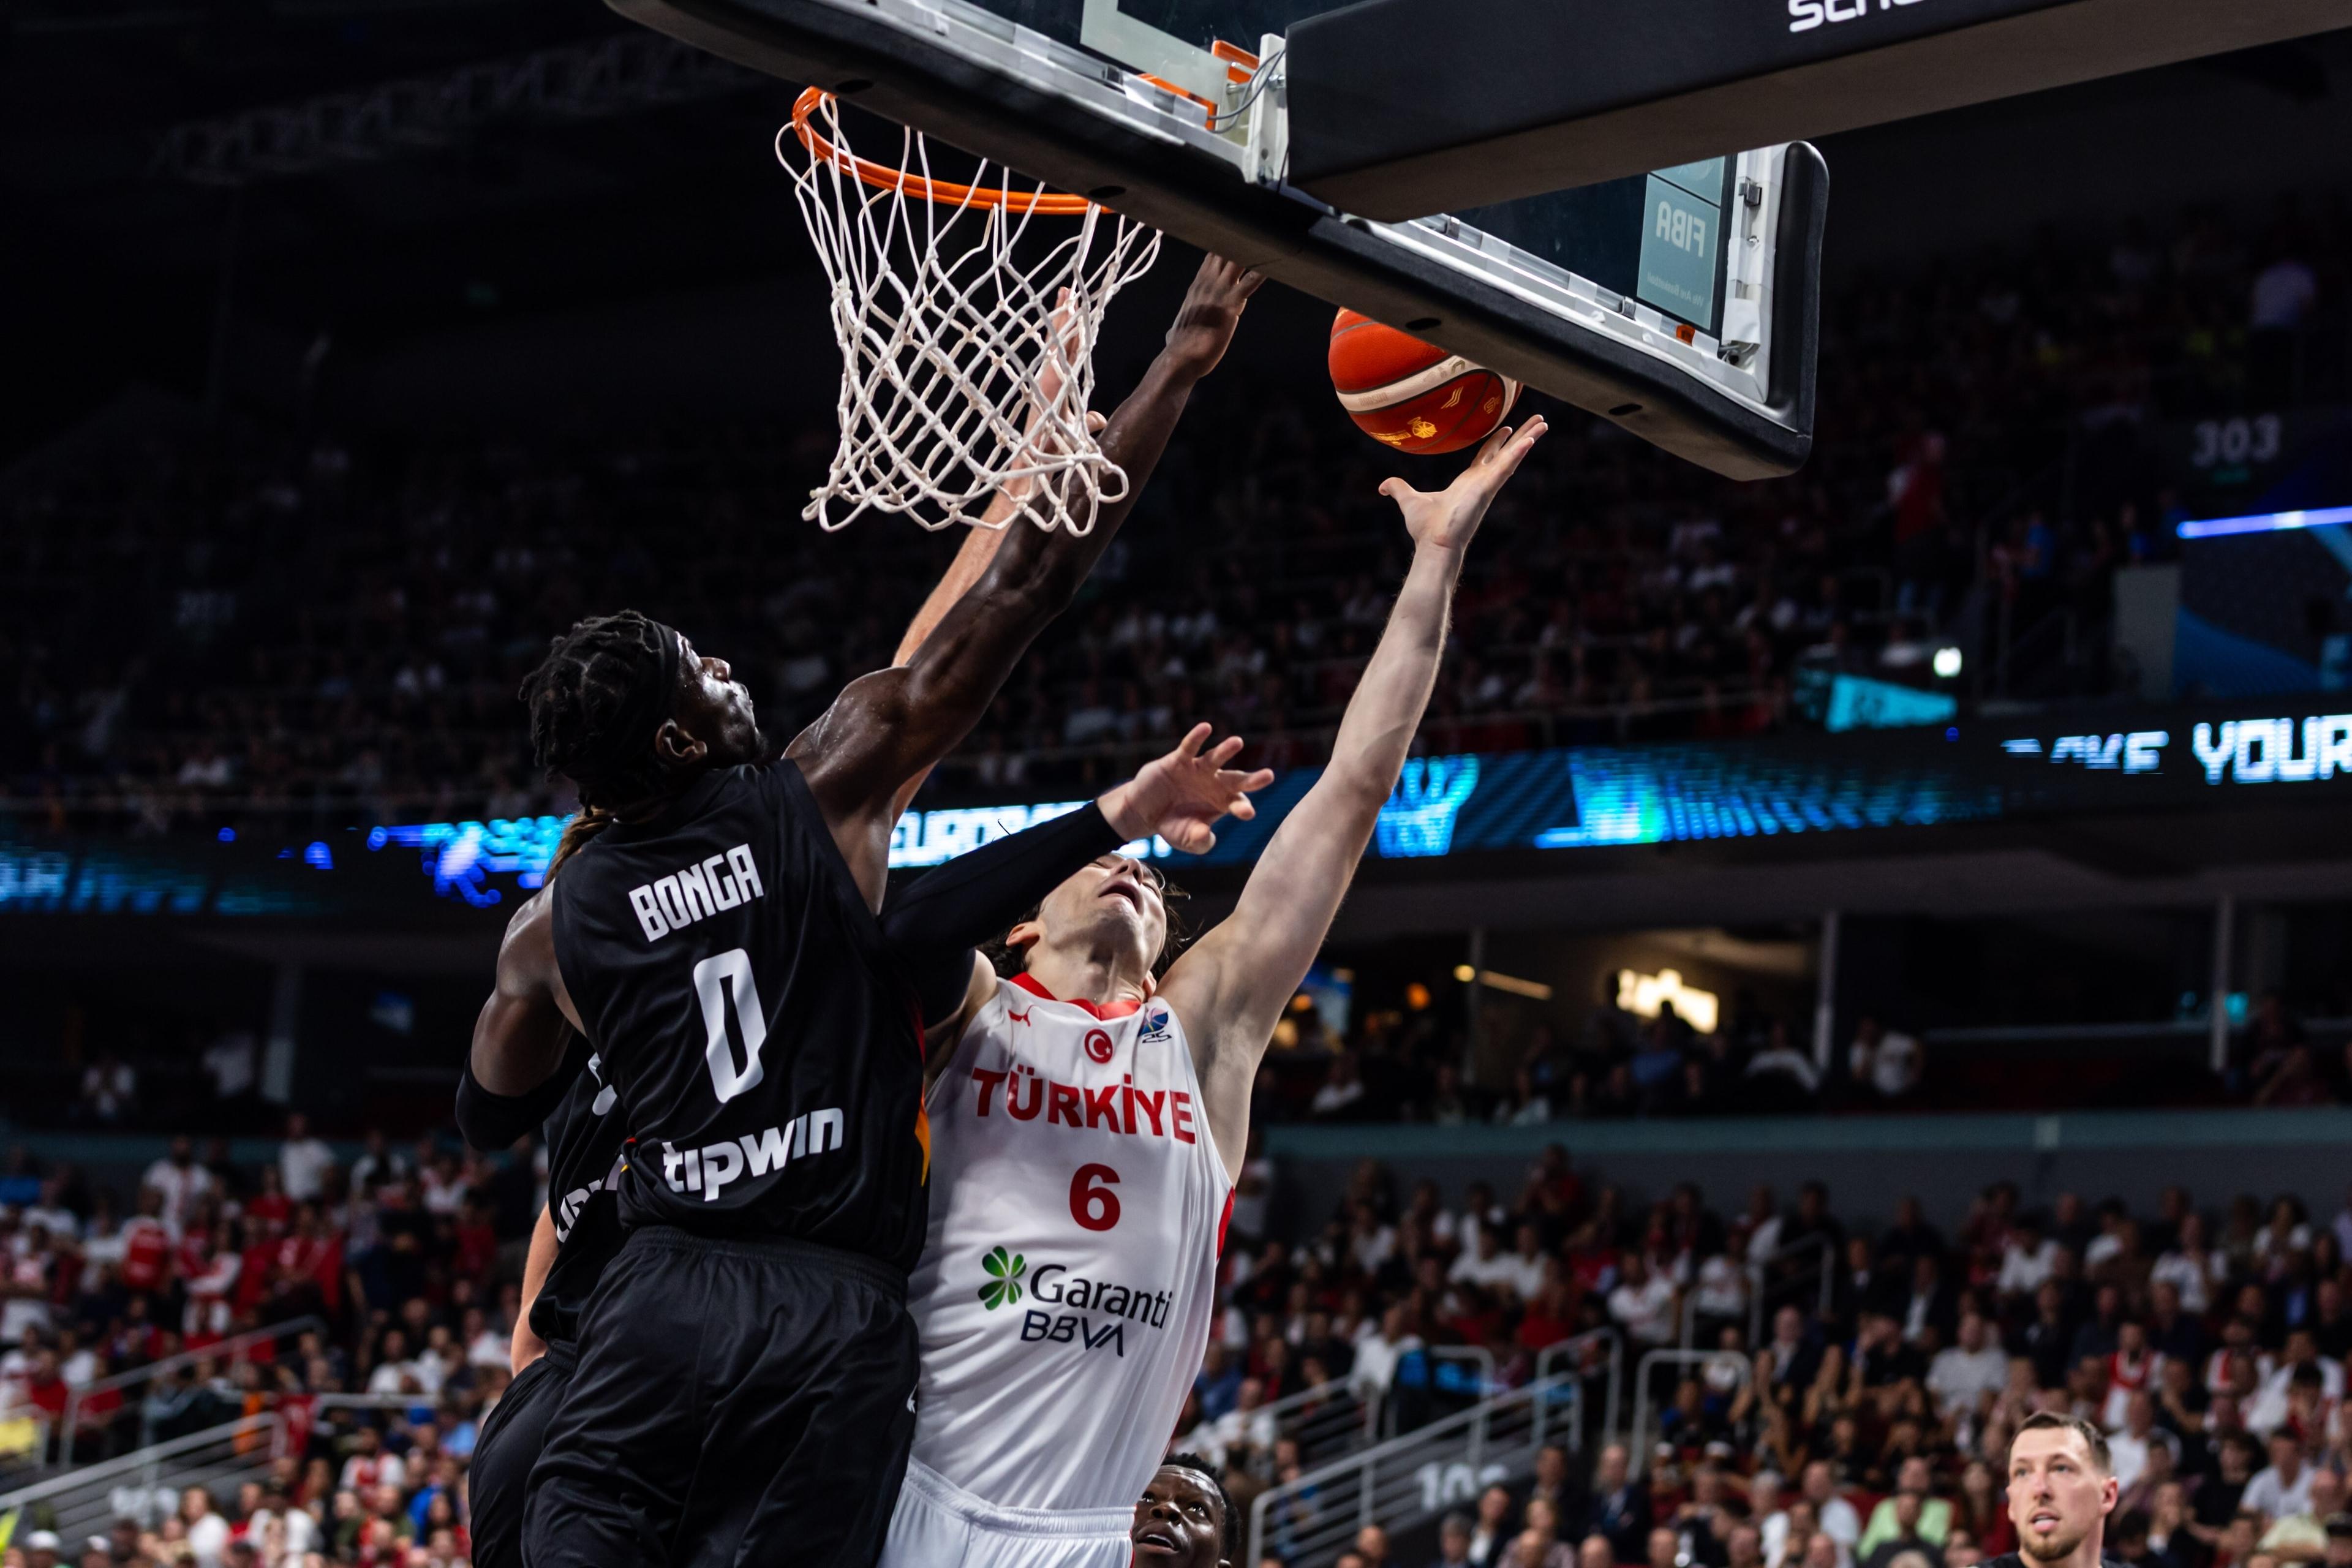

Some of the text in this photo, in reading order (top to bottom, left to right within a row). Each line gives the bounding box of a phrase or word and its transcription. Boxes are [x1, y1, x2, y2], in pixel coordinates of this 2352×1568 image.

[2192, 714, 2352, 785] YOUR
[628, 843, 764, 942] BONGA
[693, 948, 767, 1103] 0
[971, 1064, 1196, 1144] TÜRKİYE
[663, 1107, 843, 1201] tipwin
[1069, 1163, 1121, 1231] 6
[1020, 1310, 1124, 1357] BBVA
[1030, 1264, 1172, 1329] Garanti
